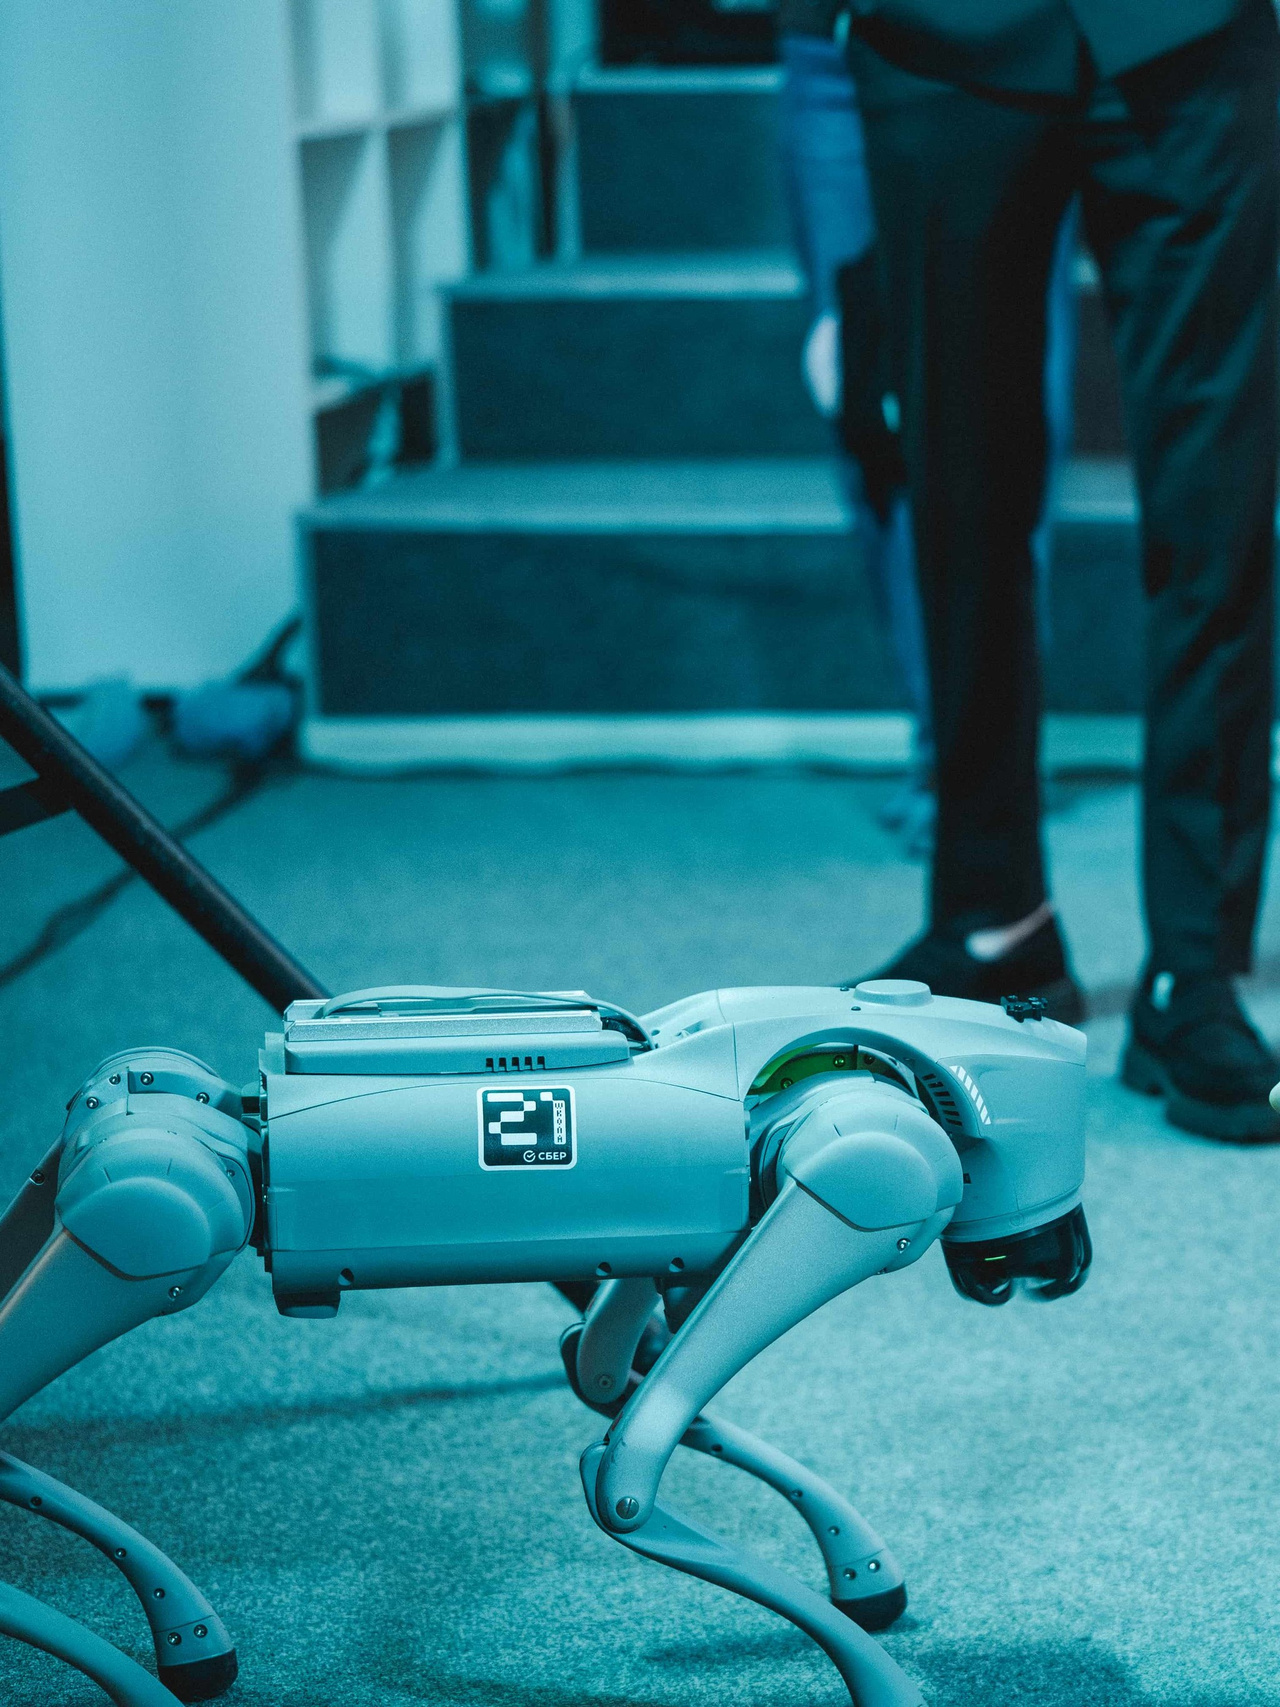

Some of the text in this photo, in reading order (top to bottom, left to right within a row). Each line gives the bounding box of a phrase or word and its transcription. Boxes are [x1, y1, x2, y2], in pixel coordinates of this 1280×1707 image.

[487, 1092, 566, 1145] 21
[554, 1102, 564, 1143] ШКОЛА
[538, 1151, 567, 1160] СБЕР
